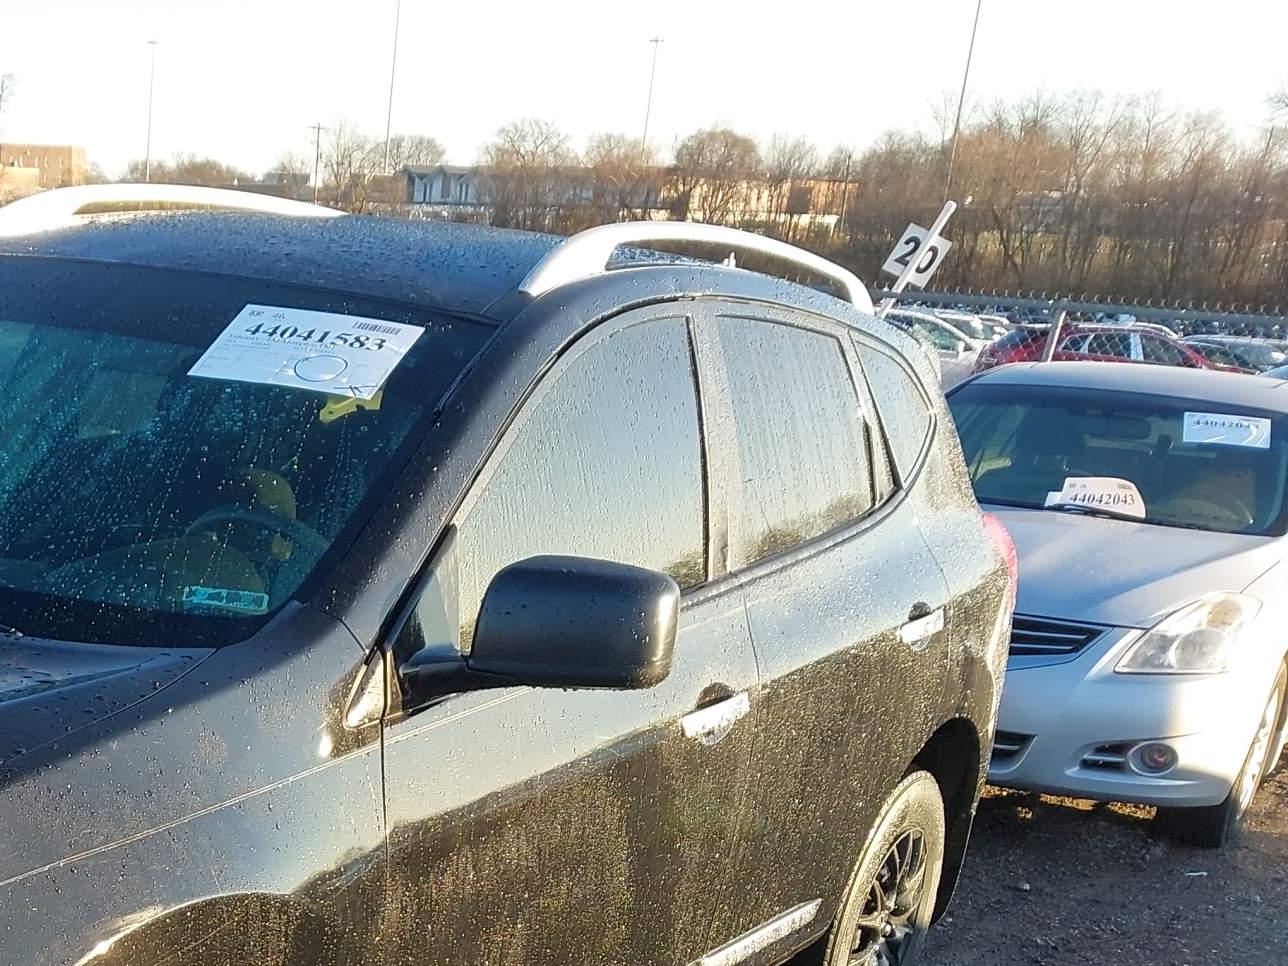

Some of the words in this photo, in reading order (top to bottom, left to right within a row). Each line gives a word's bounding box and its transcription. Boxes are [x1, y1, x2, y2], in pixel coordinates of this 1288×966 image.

[893, 235, 939, 274] 20
[245, 322, 387, 351] 44041583
[1070, 492, 1135, 506] 44042043
